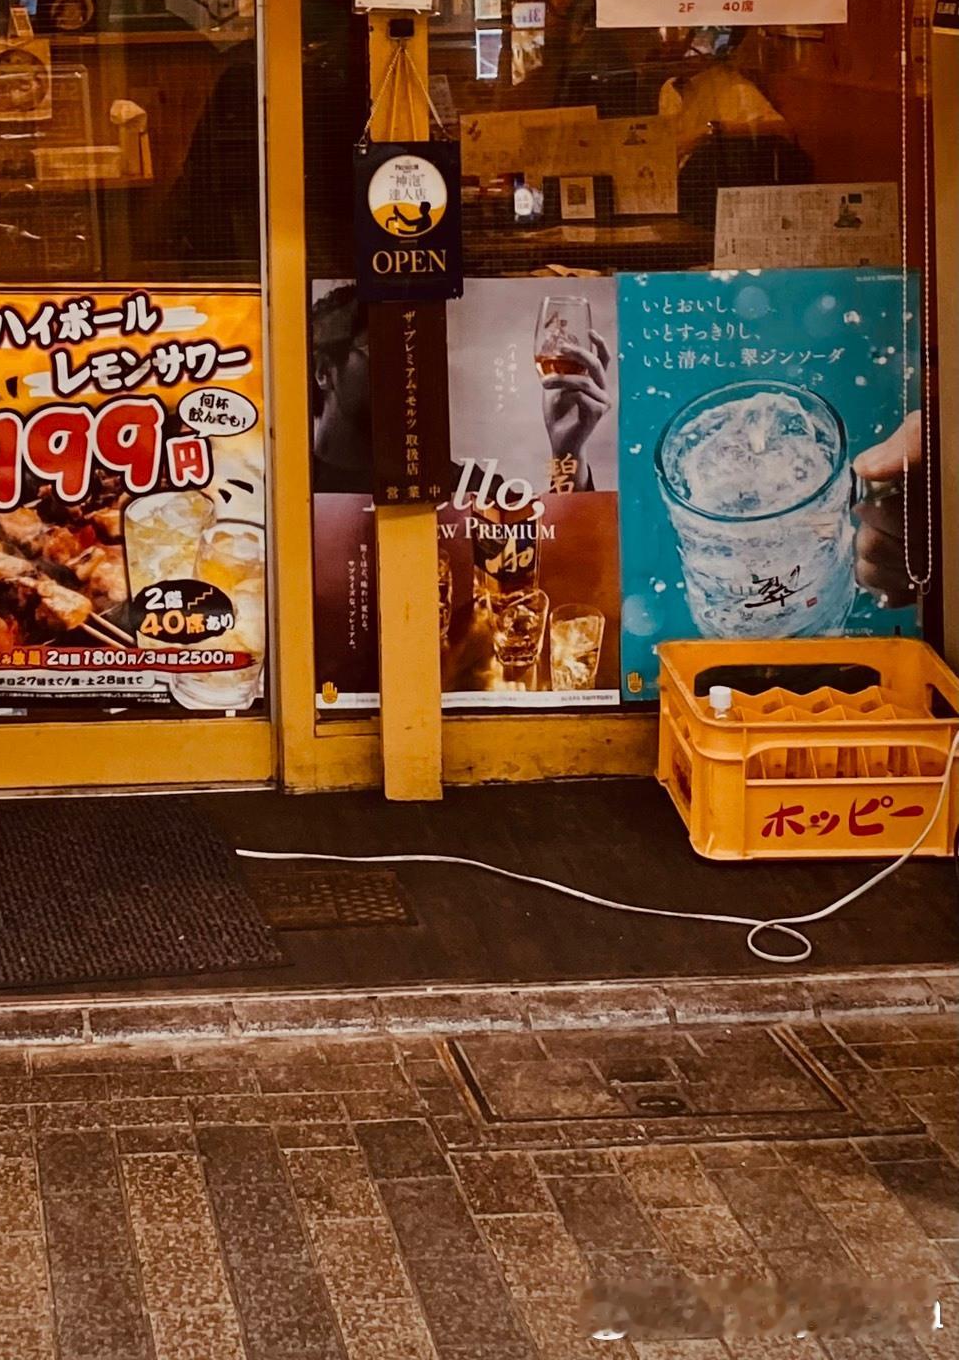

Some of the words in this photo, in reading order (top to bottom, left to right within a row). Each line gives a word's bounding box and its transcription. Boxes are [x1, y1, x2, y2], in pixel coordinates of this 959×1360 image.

[679, 3, 695, 13] 2F
[372, 249, 446, 274] OPEN
[53, 343, 248, 394] レモンサワー
[200, 392, 230, 411] 何杯
[406, 434, 419, 476] 取扱店
[386, 484, 441, 500] 営業中
[436, 458, 545, 521] llo,
[465, 517, 556, 540] PREMIUM
[761, 794, 925, 839] ホッピー
